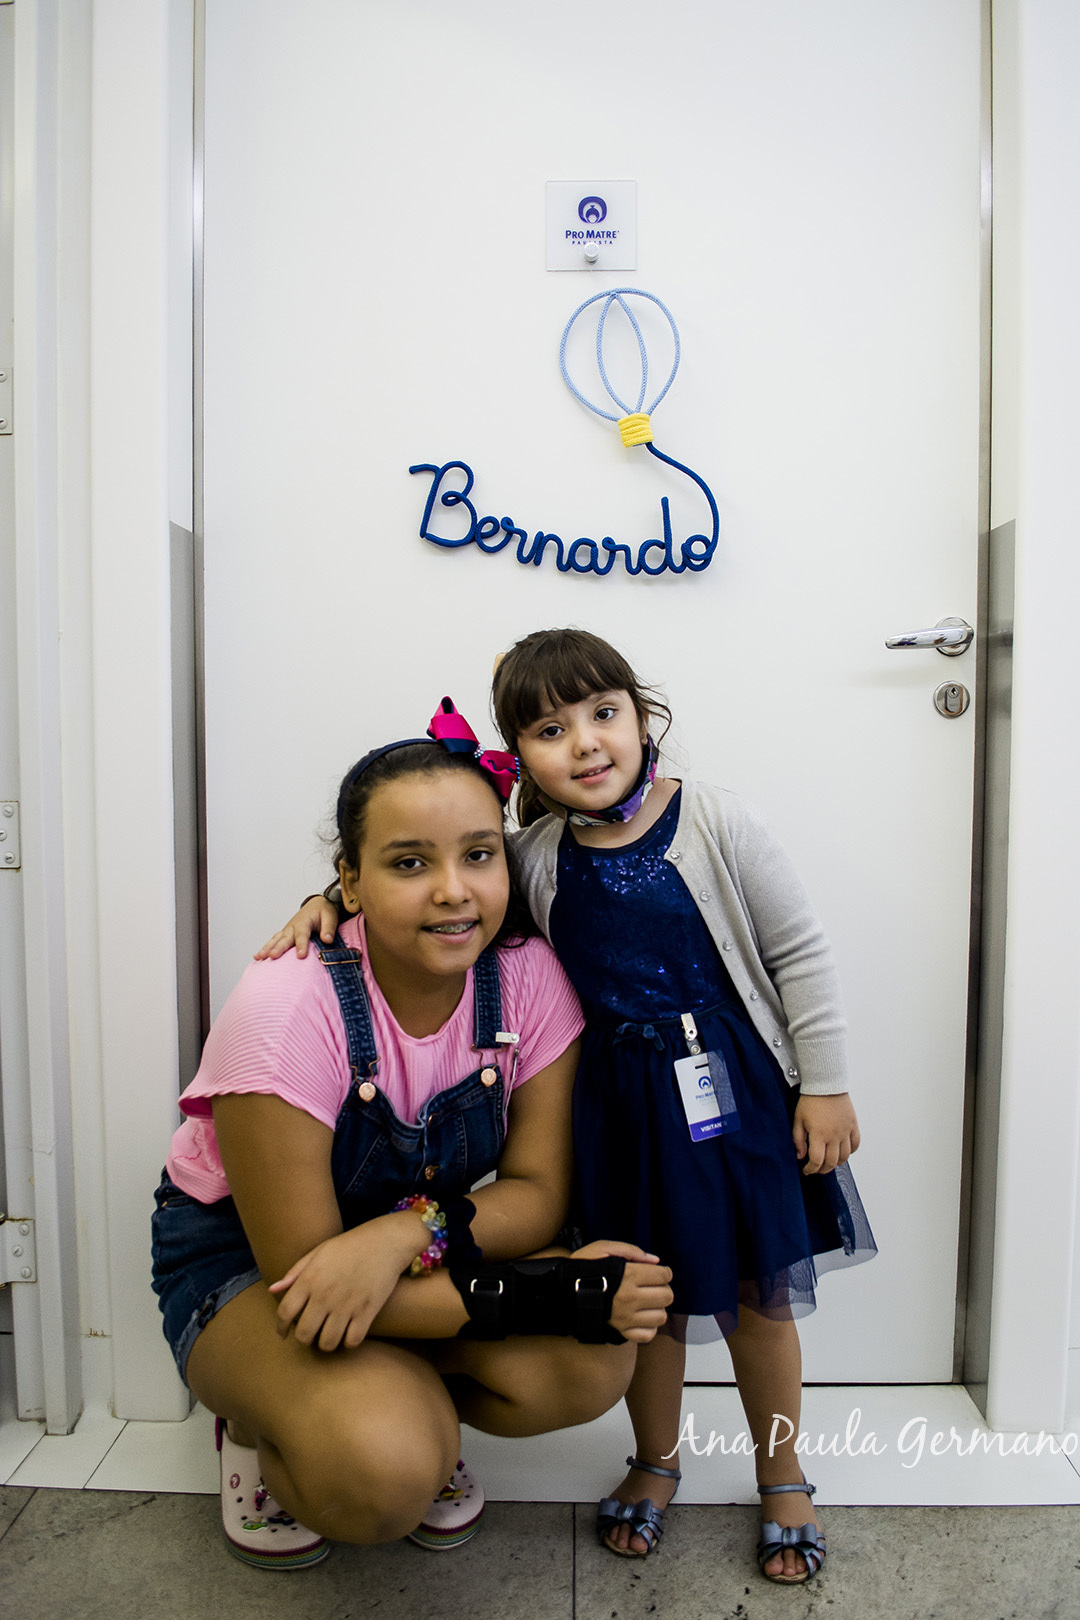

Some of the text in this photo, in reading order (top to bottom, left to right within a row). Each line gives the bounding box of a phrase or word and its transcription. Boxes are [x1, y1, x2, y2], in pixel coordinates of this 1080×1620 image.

[565, 230, 617, 239] PRO MATRE
[409, 460, 718, 576] Bernardo
